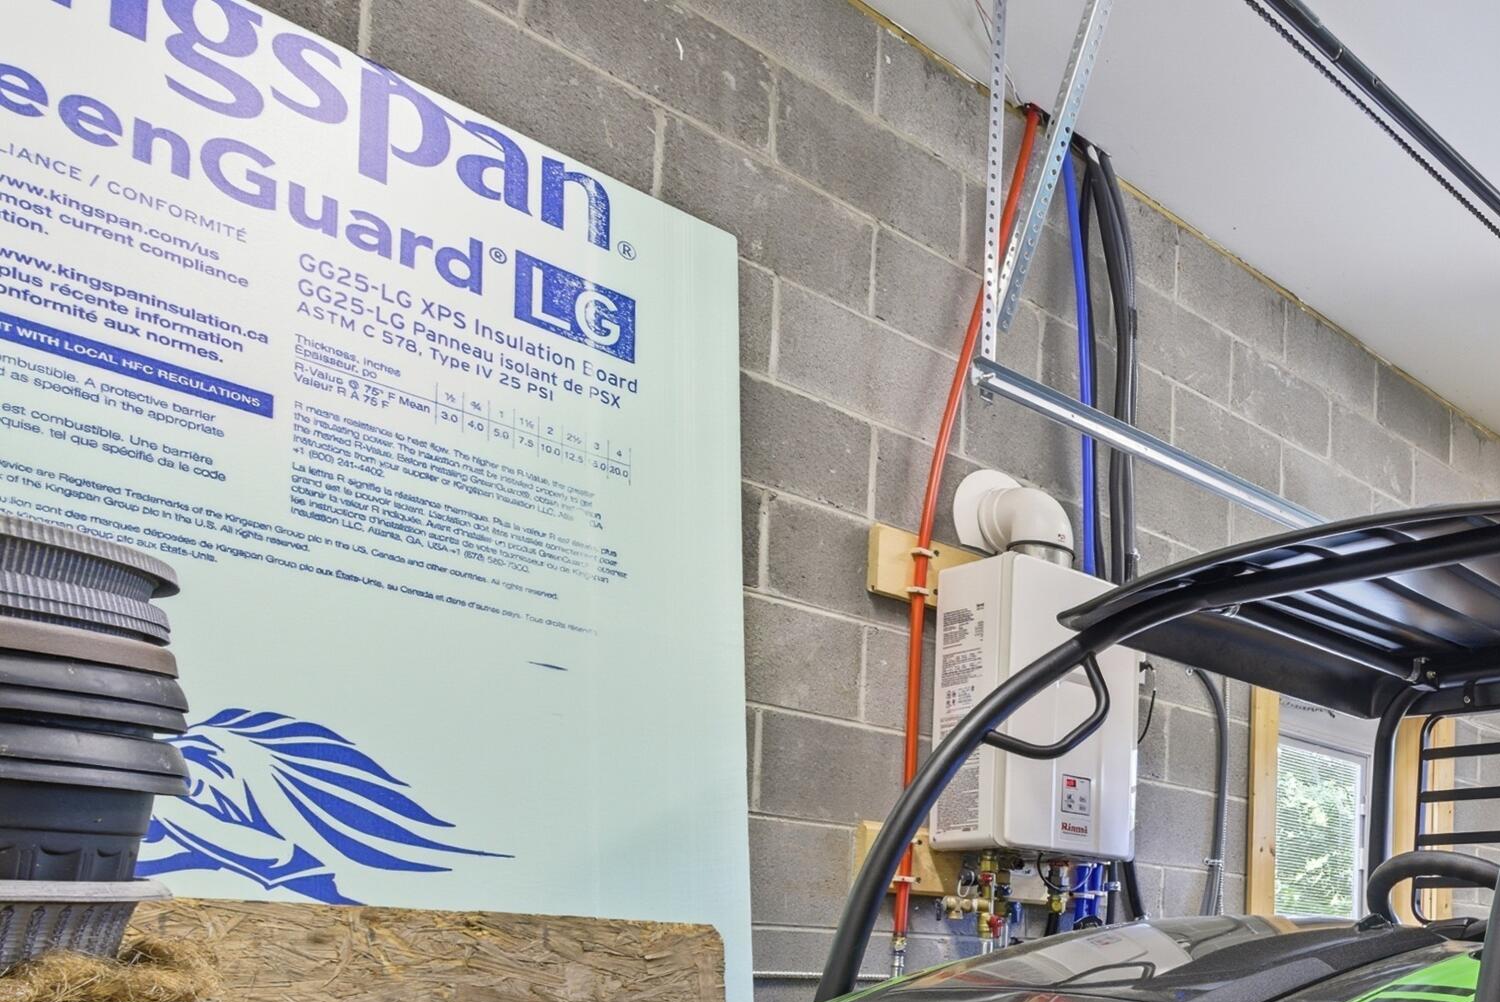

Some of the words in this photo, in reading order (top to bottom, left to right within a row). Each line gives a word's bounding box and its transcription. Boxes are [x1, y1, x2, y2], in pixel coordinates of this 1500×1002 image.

[0, 142, 82, 182] IANCE
[88, 173, 100, 188] /
[58, 213, 134, 248] current
[139, 241, 248, 289] compliance
[50, 281, 129, 316] récente
[134, 306, 243, 353] information
[298, 278, 405, 331] GG25-LG
[413, 320, 493, 364] Panneau
[500, 352, 558, 387] isolant
[563, 377, 583, 396] de
[589, 385, 620, 410] PSX
[299, 252, 412, 310] GG25-LG
[420, 297, 466, 330] XPS
[474, 318, 575, 372] Insulation
[531, 265, 622, 347] LG
[0, 353, 79, 384] mbustible.
[296, 300, 355, 333] ASTM
[362, 323, 375, 339] C
[382, 329, 422, 357] 578,
[429, 346, 470, 373] Type
[476, 363, 493, 379] IV
[498, 372, 521, 390] 25
[527, 381, 553, 402] PSI
